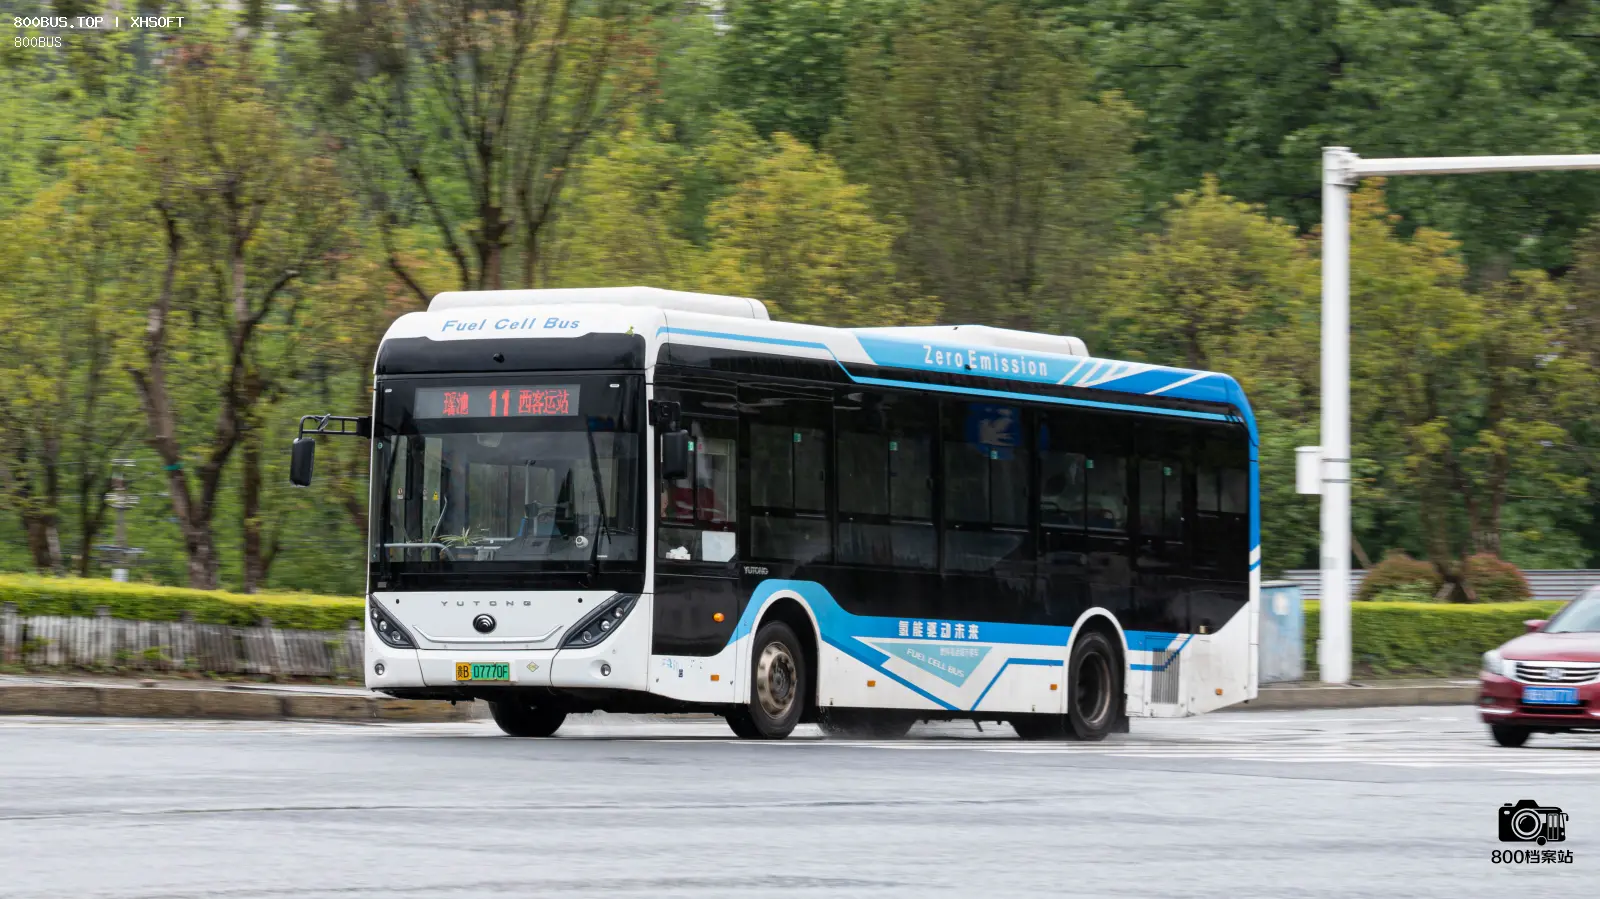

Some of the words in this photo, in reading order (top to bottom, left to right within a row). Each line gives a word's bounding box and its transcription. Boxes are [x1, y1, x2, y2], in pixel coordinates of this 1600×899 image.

[441, 318, 487, 333] Fuel
[494, 317, 536, 331] Cell
[543, 317, 581, 329] Bus
[922, 344, 963, 368] Zero
[967, 349, 1048, 377] Emission
[488, 389, 511, 417] 11
[518, 388, 570, 415] 西客运站
[744, 565, 769, 575] YUTONG
[440, 600, 532, 608] YUTONG
[906, 648, 926, 662] FUEL
[928, 656, 947, 671] CELL
[947, 664, 965, 678] BUS
